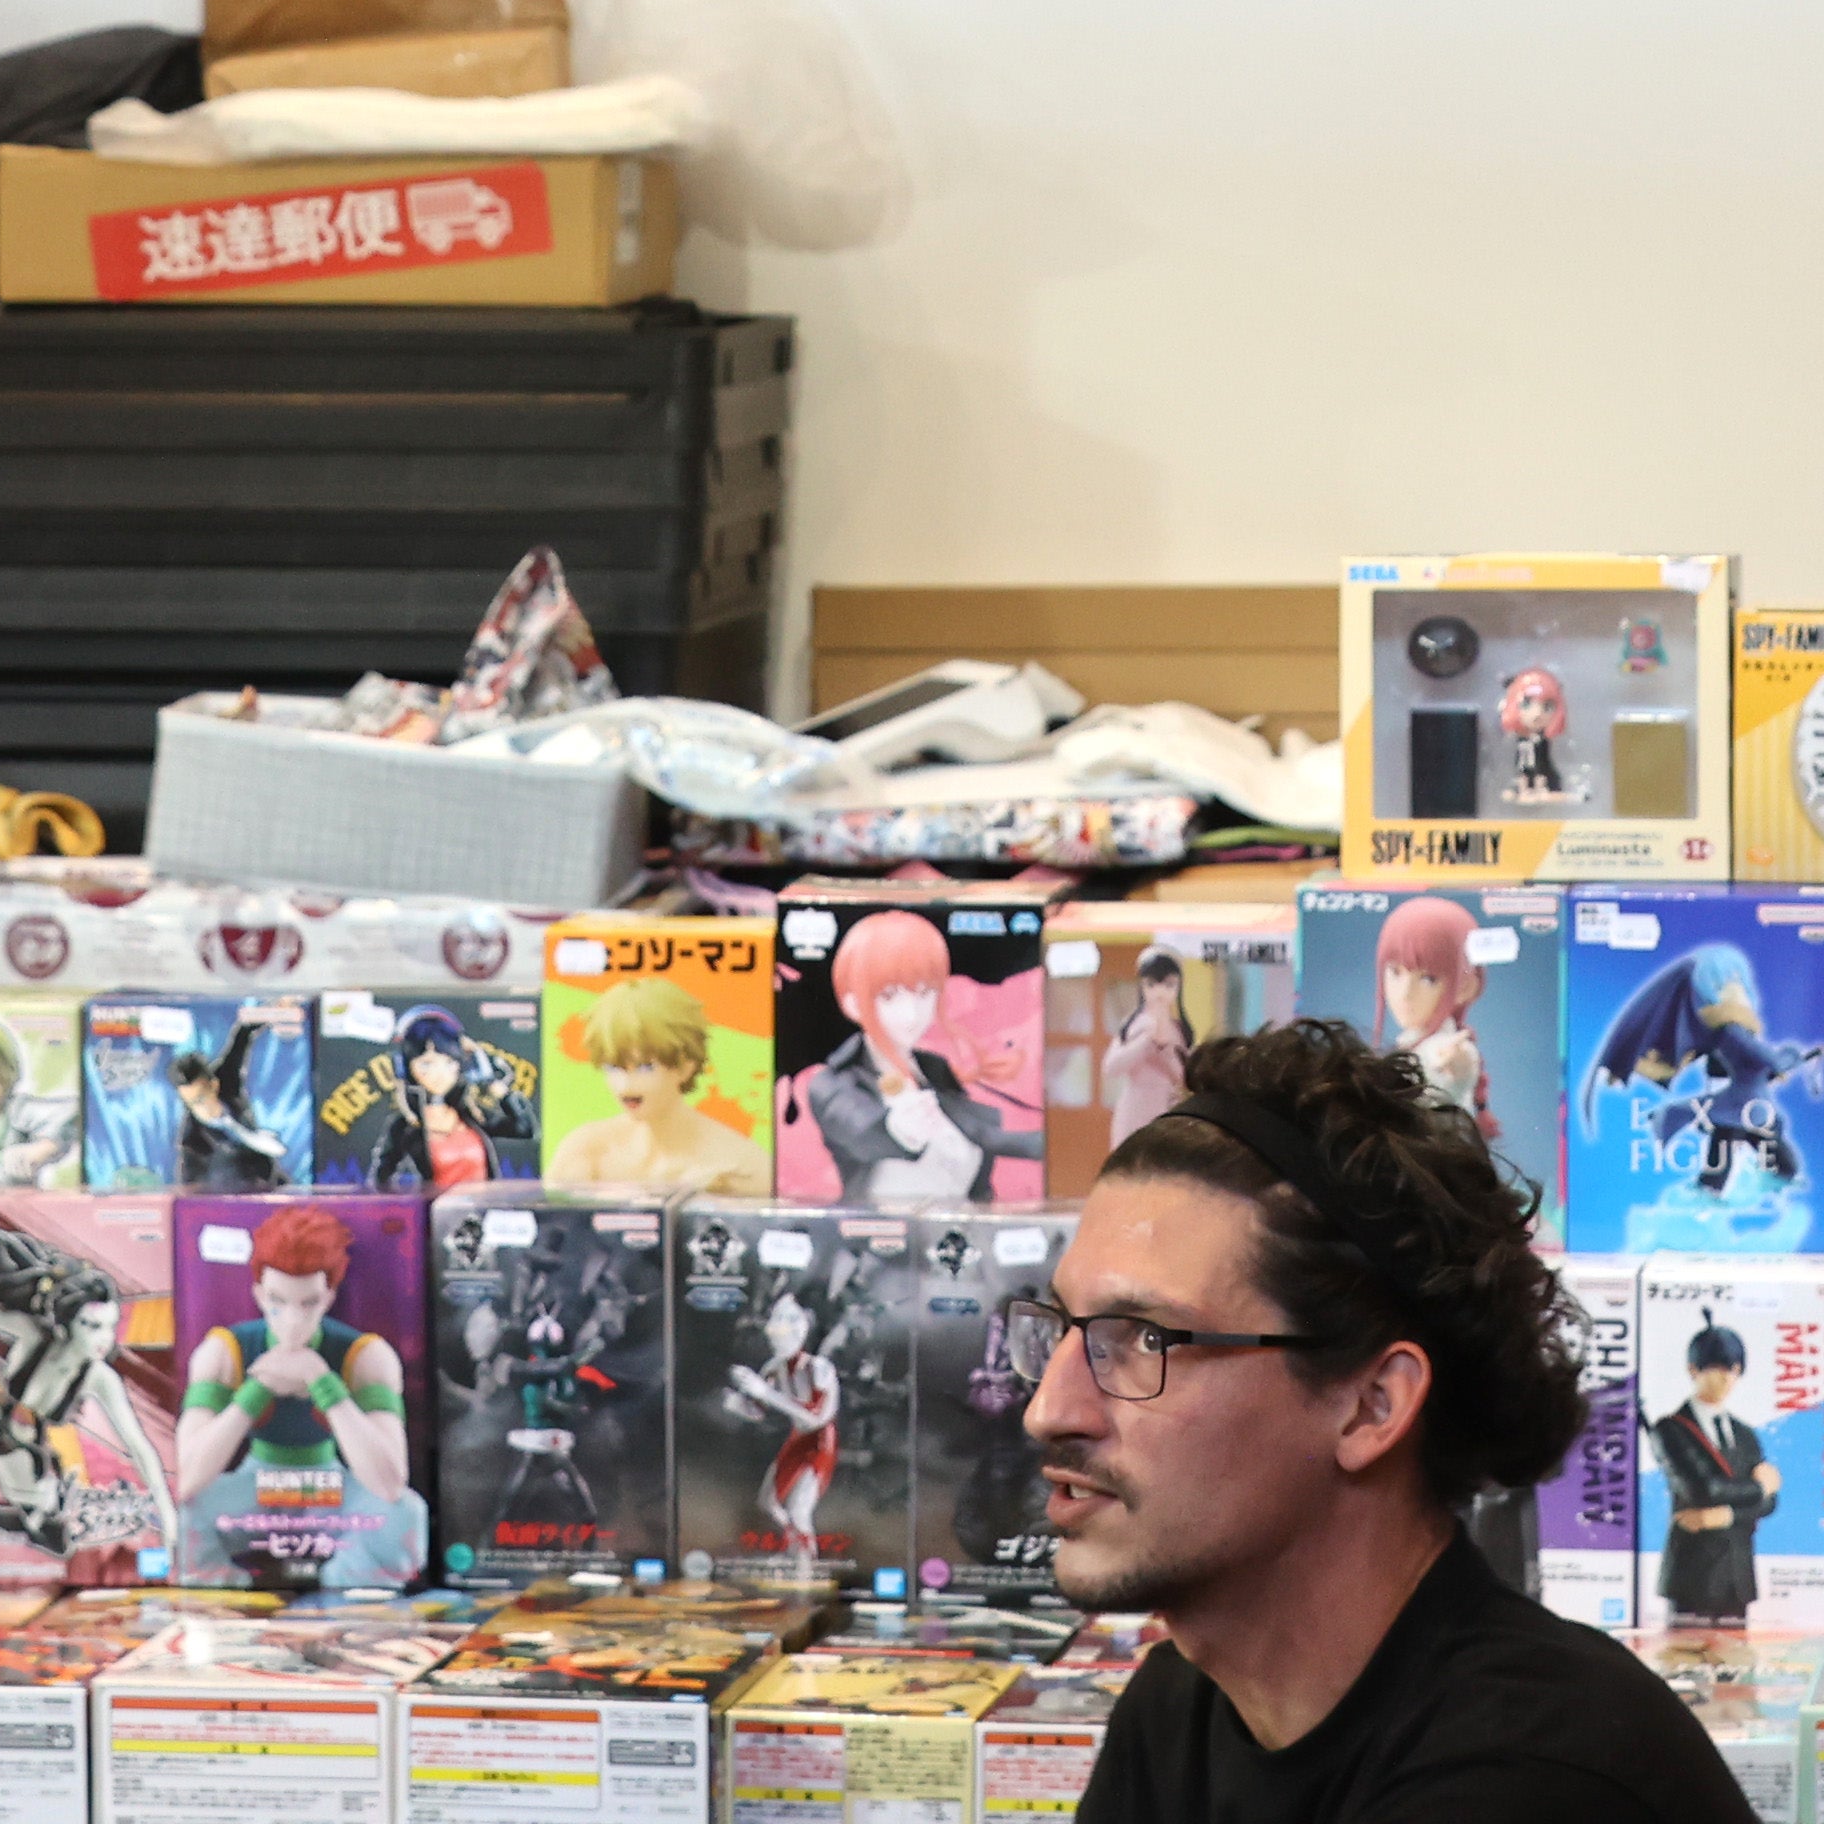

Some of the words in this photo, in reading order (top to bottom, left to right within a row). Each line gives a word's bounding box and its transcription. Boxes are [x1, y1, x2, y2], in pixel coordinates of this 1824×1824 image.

[560, 936, 757, 972] ンソーマン
